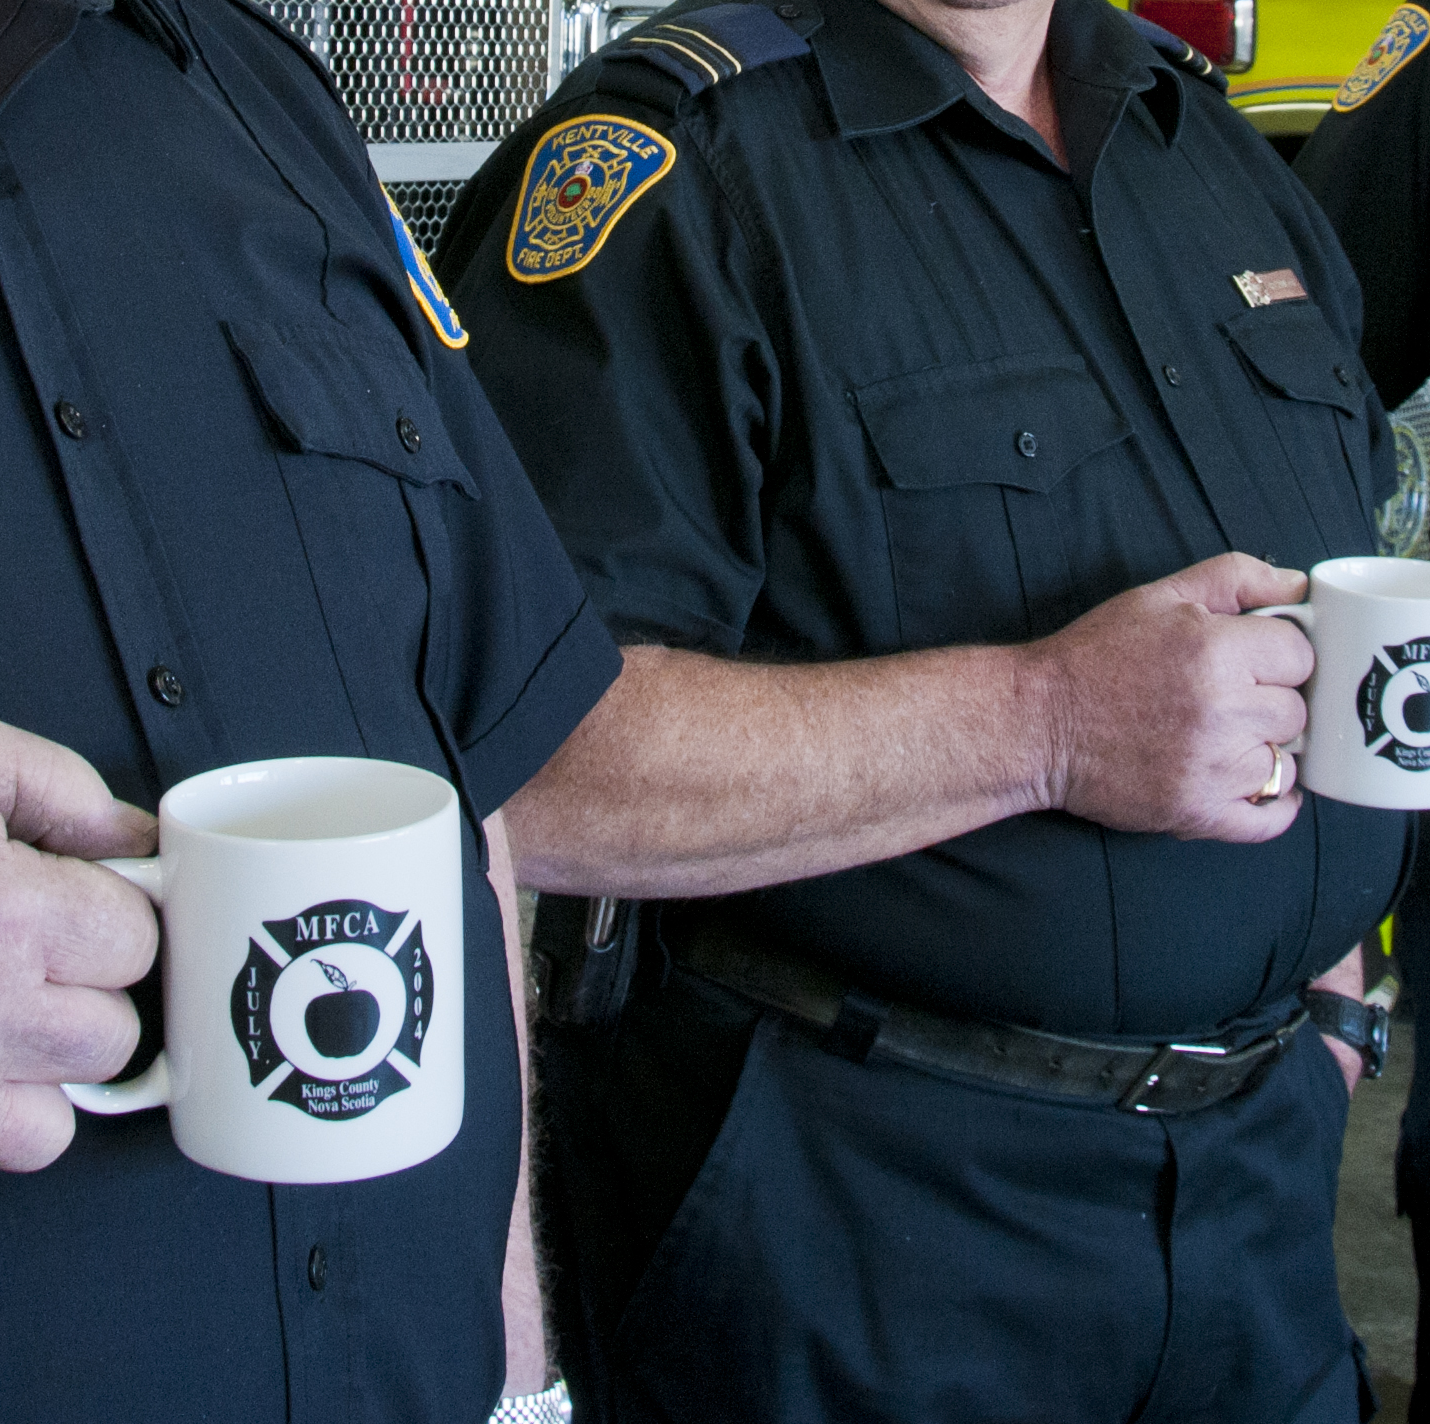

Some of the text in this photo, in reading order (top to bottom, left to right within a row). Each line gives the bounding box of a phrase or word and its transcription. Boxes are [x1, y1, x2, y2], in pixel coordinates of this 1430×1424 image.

[551, 124, 659, 160] KENTVILLE
[517, 247, 545, 269] FIRE
[295, 909, 381, 942] MFCA
[413, 947, 423, 1040] 2004
[246, 966, 262, 1060] JULY
[301, 1077, 380, 1101] Kings County
[308, 1094, 376, 1114] Nova Scotia
